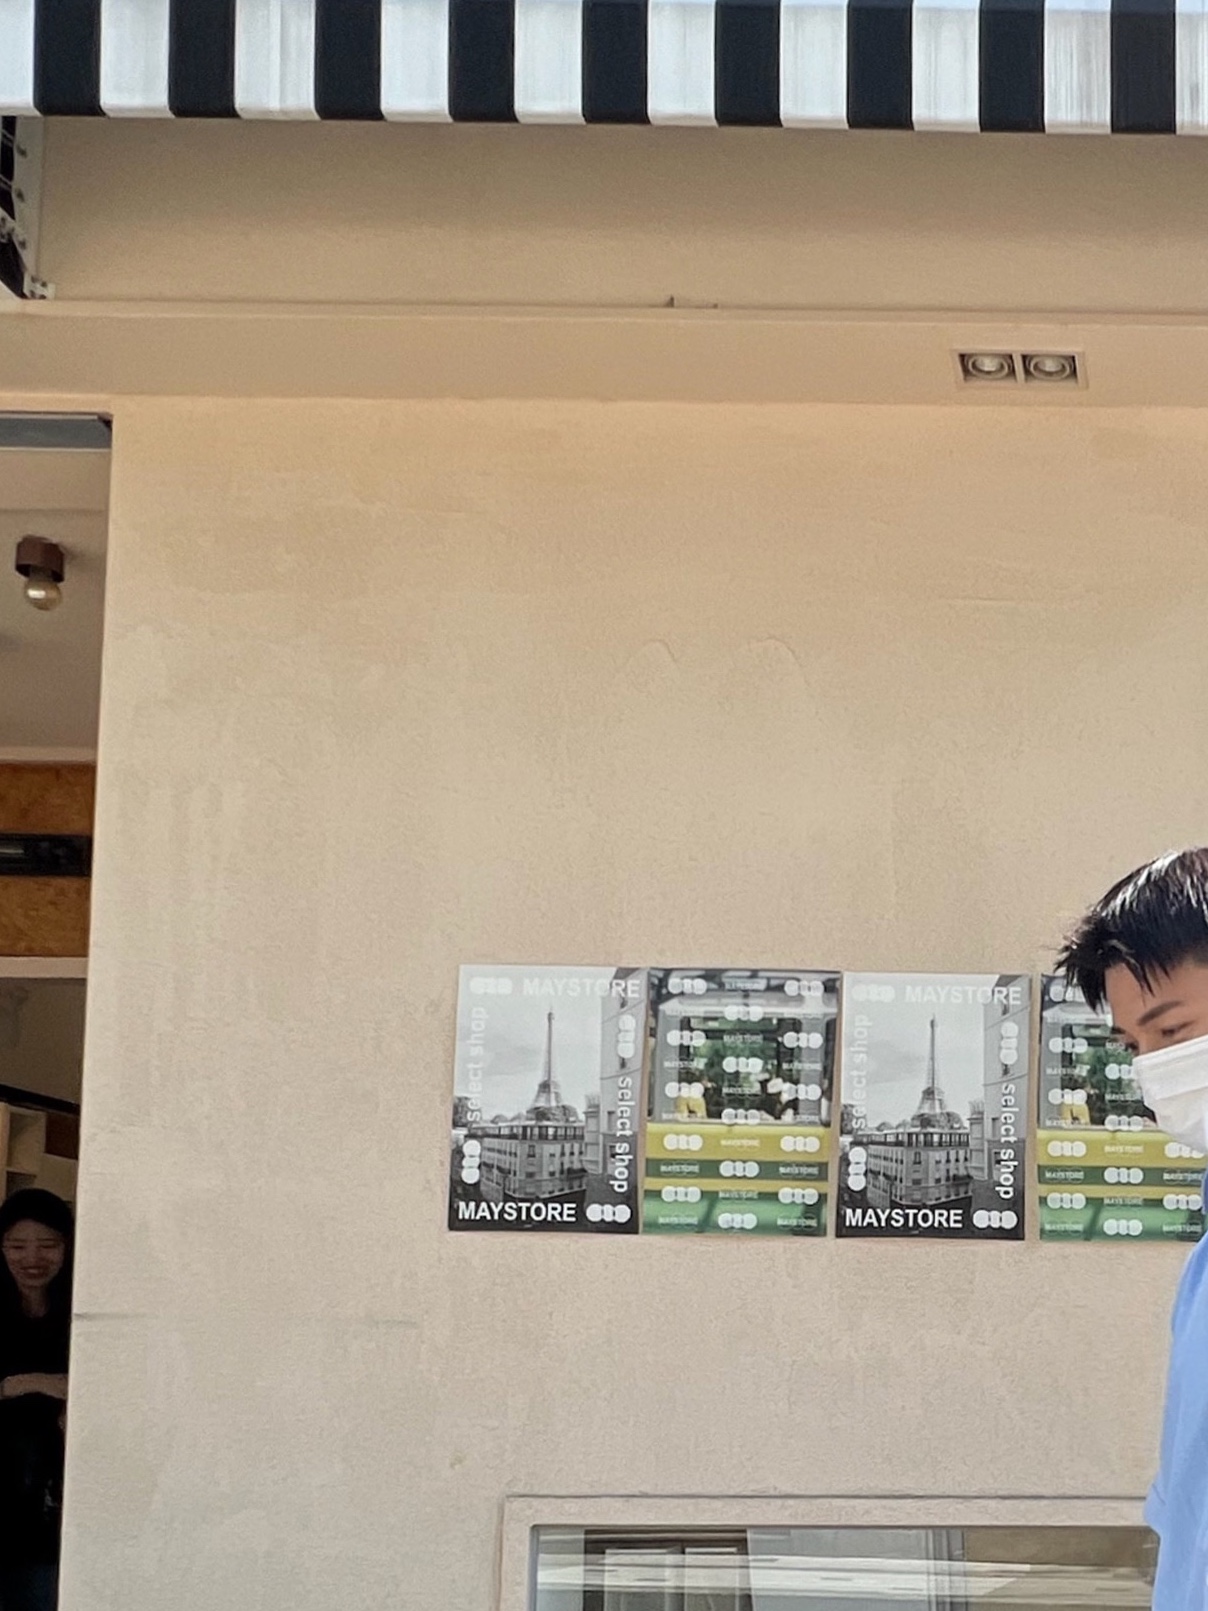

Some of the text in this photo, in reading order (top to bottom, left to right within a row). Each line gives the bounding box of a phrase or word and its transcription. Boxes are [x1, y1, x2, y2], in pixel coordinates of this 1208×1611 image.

[523, 978, 640, 998] MAYSTORE
[904, 985, 1022, 1005] MAYSTORE
[466, 1007, 489, 1122] select shop
[850, 1015, 873, 1129] select shop
[609, 1077, 636, 1193] select shop
[995, 1083, 1019, 1199] select shop
[458, 1201, 577, 1222] MAYSTORE
[845, 1208, 963, 1228] MAYSTORE
